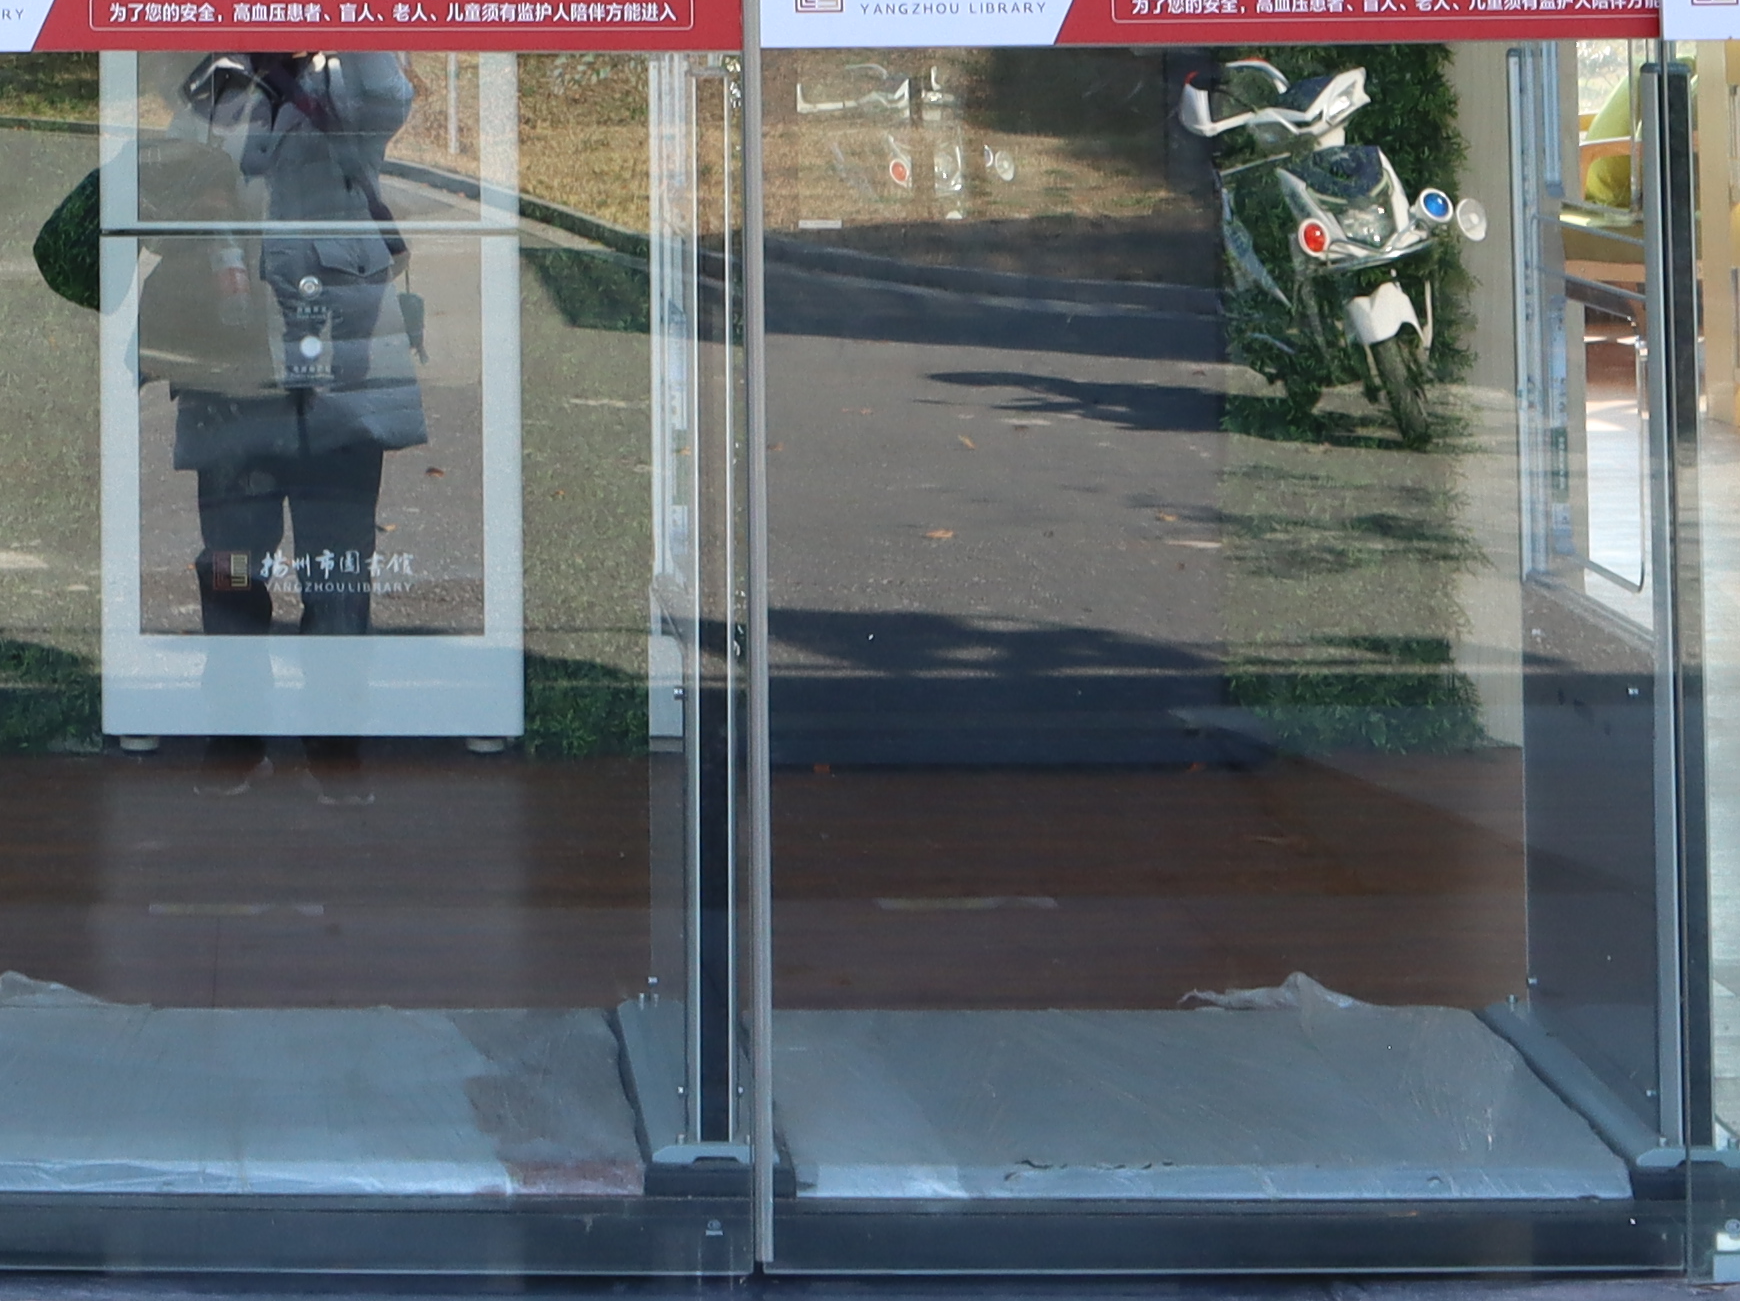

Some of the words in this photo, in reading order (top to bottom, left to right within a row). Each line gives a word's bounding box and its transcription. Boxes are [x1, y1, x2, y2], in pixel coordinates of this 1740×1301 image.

[108, 2, 677, 26] 为了您的安全，高血压患者、盲人、老人、儿童须有监护人陪伴方能进入
[858, 1, 964, 16] YANGZHOU
[969, 0, 1048, 14] LIBRARY
[264, 582, 345, 593] YANGZHOU
[348, 582, 413, 594] LIBRARY
